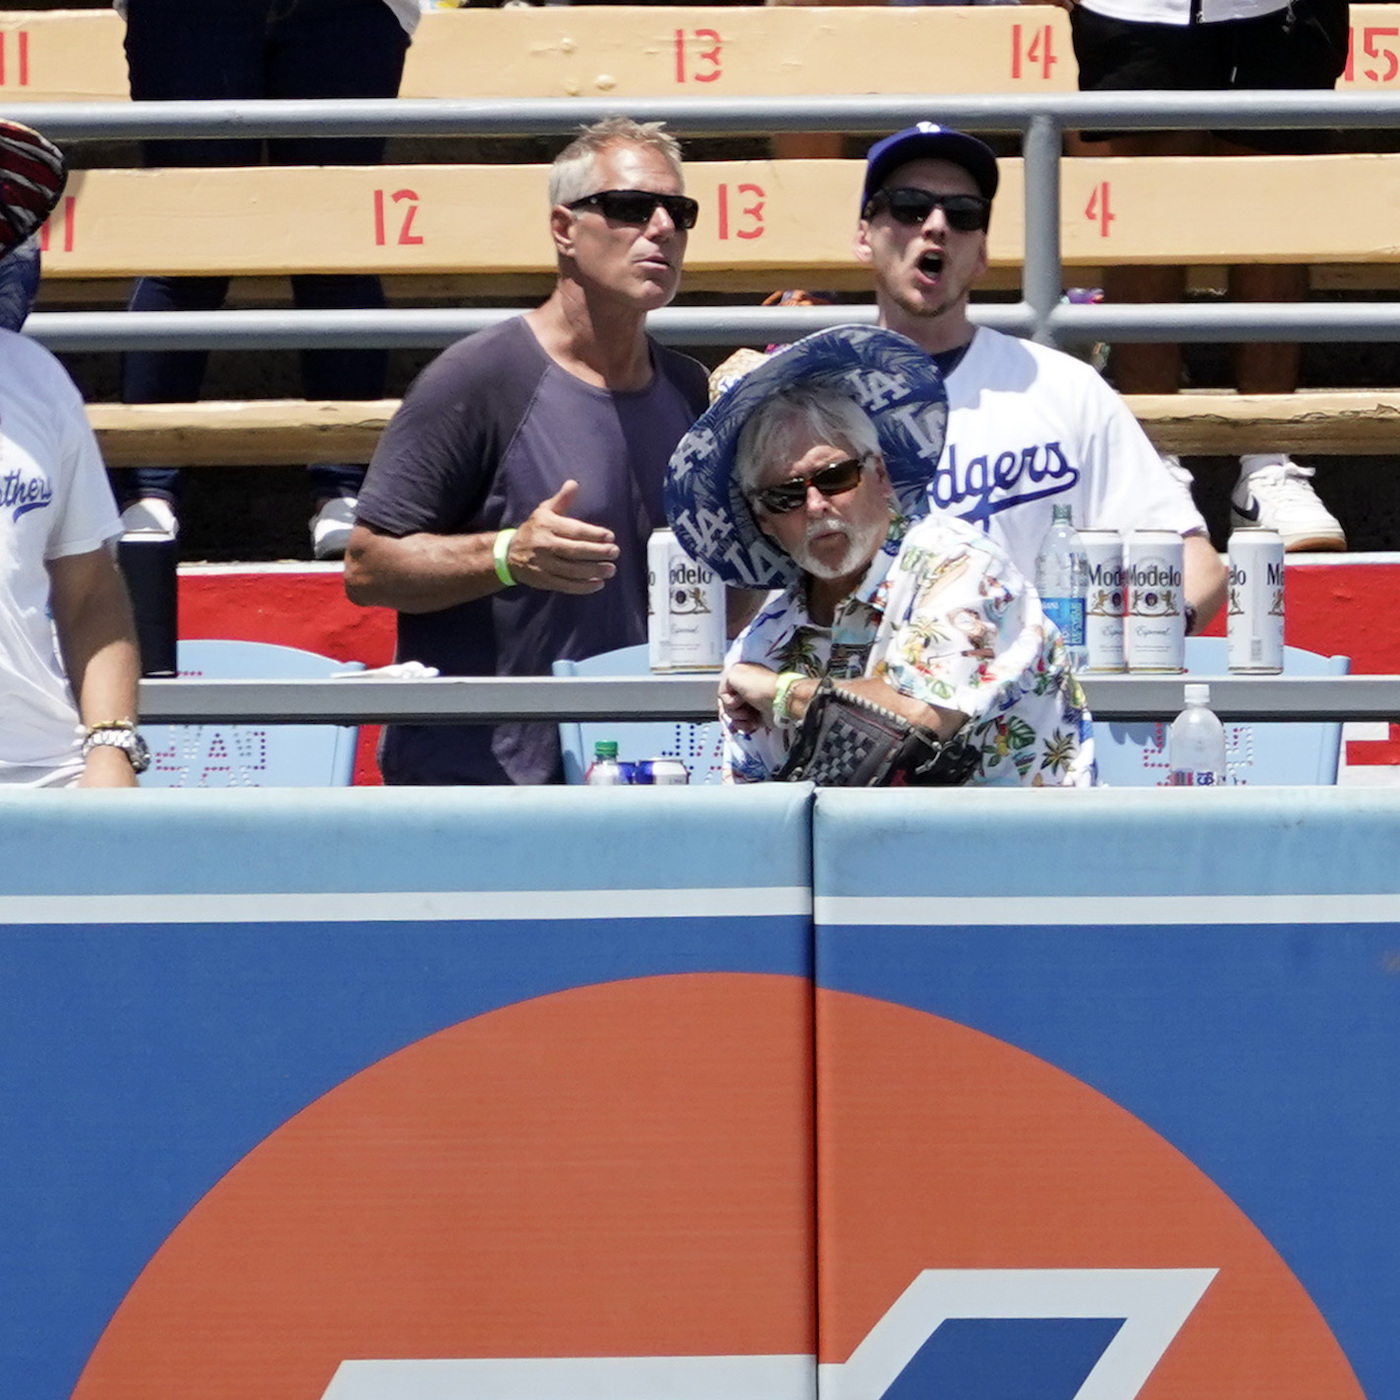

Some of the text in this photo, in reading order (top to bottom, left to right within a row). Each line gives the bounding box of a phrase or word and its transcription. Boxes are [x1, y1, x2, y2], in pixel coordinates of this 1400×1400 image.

[677, 28, 723, 83] 13
[1012, 24, 1058, 80] 14
[374, 189, 425, 246] 12
[718, 184, 766, 240] 13
[1085, 182, 1115, 238] 4
[928, 441, 1080, 536] dgers
[669, 563, 714, 586] odelo
